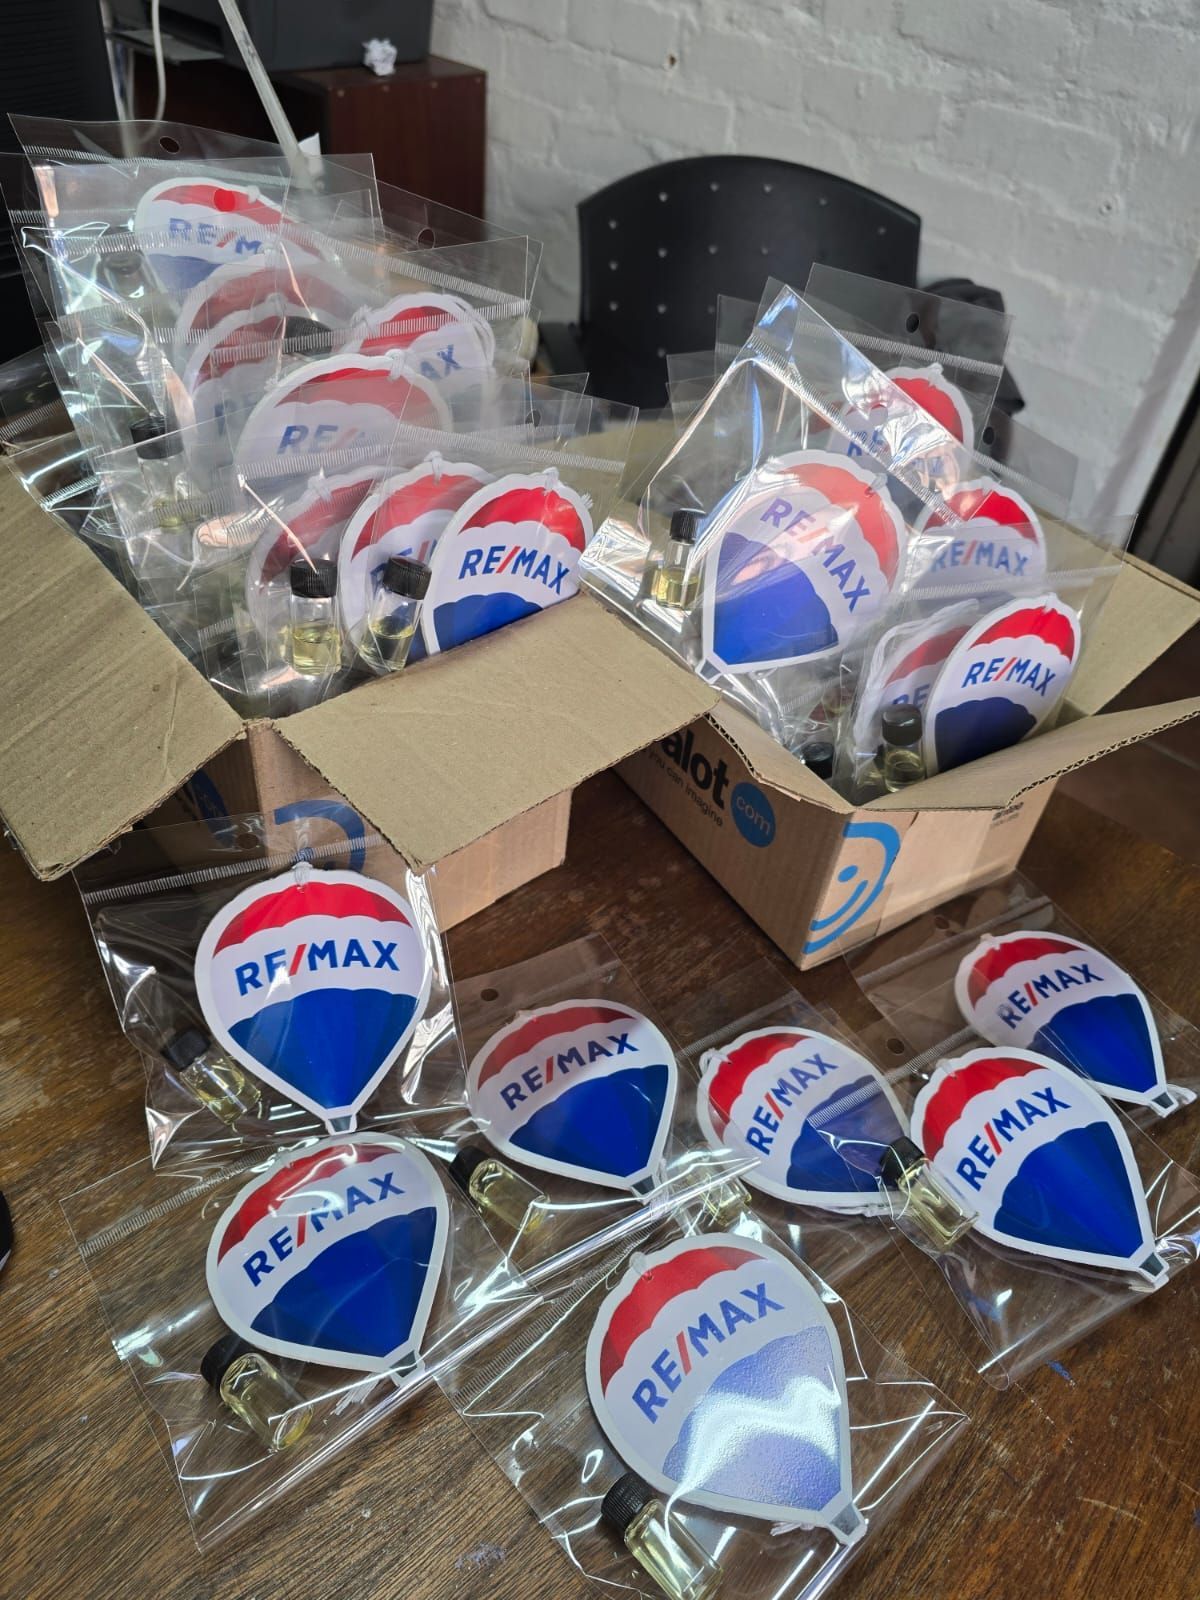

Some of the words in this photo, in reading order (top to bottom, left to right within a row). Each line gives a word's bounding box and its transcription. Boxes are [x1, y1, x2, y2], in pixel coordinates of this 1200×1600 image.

[169, 217, 265, 256] RE/M
[458, 545, 570, 595] RE/MAX
[759, 496, 871, 613] RE/MAX
[930, 539, 1029, 577] RE/MAX
[961, 656, 1057, 697] RE/MAX
[685, 783, 724, 828] imagine
[735, 796, 772, 836] com
[234, 938, 401, 996] RE/MAX
[995, 963, 1104, 1030] RE/MAX
[499, 1032, 639, 1111] RE/MAX
[745, 1052, 839, 1156] RE/MAX
[957, 1086, 1072, 1192] RE/MAX
[241, 1171, 406, 1288] RE/MAX
[630, 1281, 786, 1424] RE/MAX
